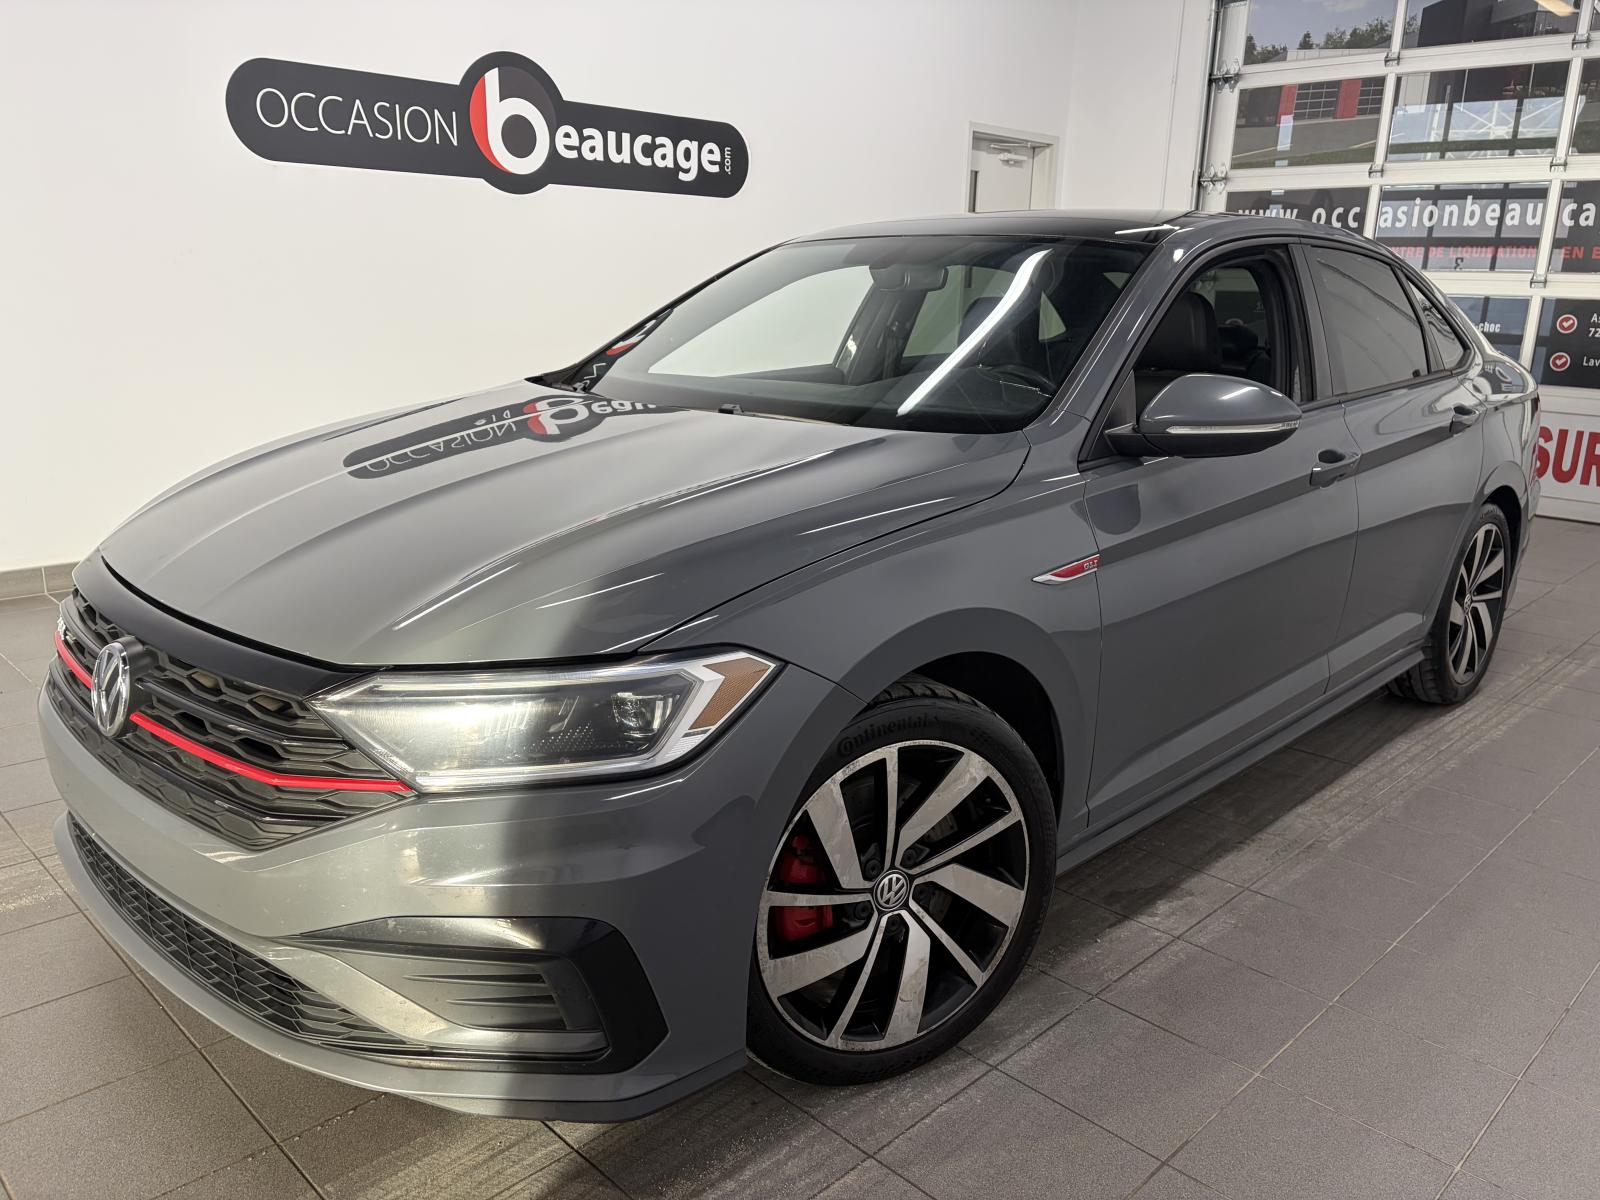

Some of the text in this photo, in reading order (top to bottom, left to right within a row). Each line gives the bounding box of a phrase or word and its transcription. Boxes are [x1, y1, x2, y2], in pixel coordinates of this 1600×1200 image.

[255, 87, 459, 147] OCCASION
[724, 146, 732, 175] .com
[1560, 246, 1584, 259] EN
